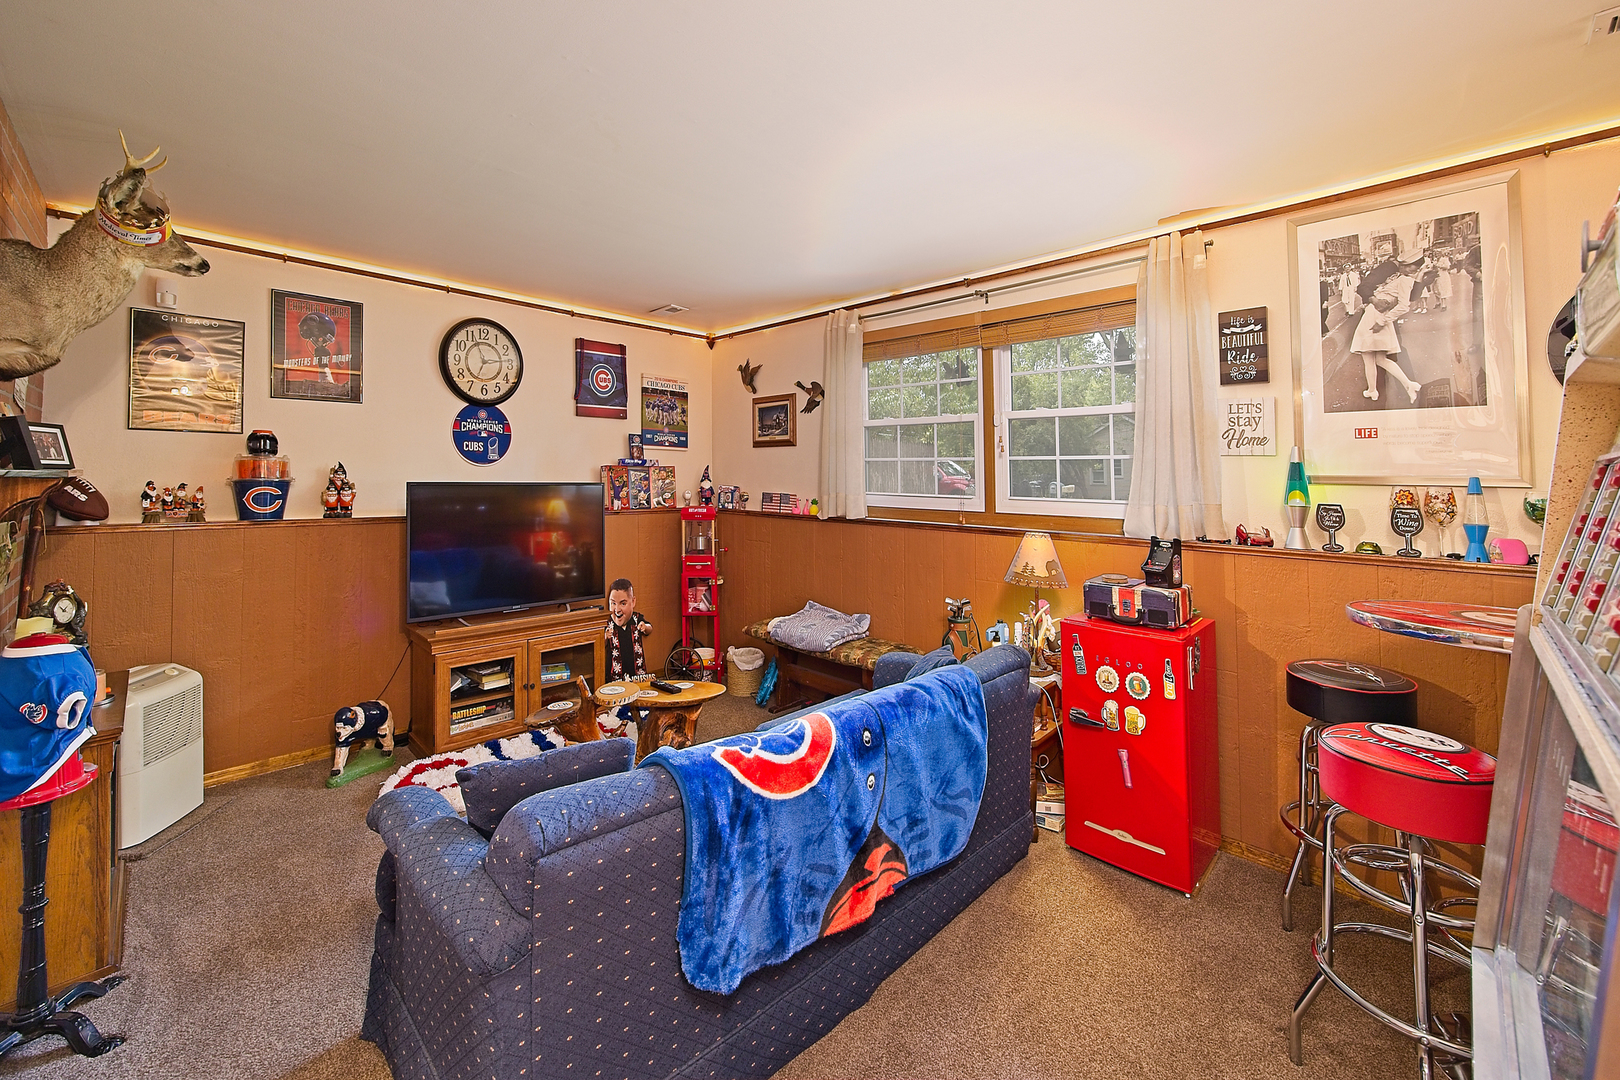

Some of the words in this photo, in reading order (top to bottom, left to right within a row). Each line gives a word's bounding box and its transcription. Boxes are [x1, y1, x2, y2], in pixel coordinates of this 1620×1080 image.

[98, 213, 128, 238] Medieval
[287, 299, 321, 314] CHICAGO
[161, 314, 219, 328] CHICAGO
[1247, 314, 1255, 324] is
[465, 329, 475, 342] 11
[477, 327, 490, 341] 12
[494, 333, 499, 346] 1
[1221, 331, 1265, 350] BEAUTIFUL
[454, 339, 467, 352] 10
[502, 344, 510, 356] 2
[312, 355, 320, 366] OF
[321, 355, 330, 365] THE
[453, 353, 461, 366] 9
[1227, 348, 1260, 364] Ride
[506, 358, 514, 371] 3
[457, 367, 465, 381] 8
[502, 372, 511, 384] 4
[467, 380, 474, 392] 7
[480, 384, 488, 396] 6
[493, 382, 501, 393] 5
[646, 380, 671, 389] CHICAGO
[671, 383, 686, 391] CUBS
[1228, 402, 1263, 414] LET'S
[142, 410, 232, 425] BEARS
[1228, 415, 1262, 431] stay
[461, 421, 504, 434] CHAMPIONS
[1355, 428, 1377, 438] LIFE
[653, 434, 679, 444] CHAMPIONS
[1221, 427, 1270, 450] Home
[463, 441, 485, 452] CUBS
[1394, 518, 1419, 527] Wine
[1095, 654, 1143, 670] IGLOO
[452, 705, 487, 720] BATTLESHIP
[1322, 727, 1470, 780] Corvette
